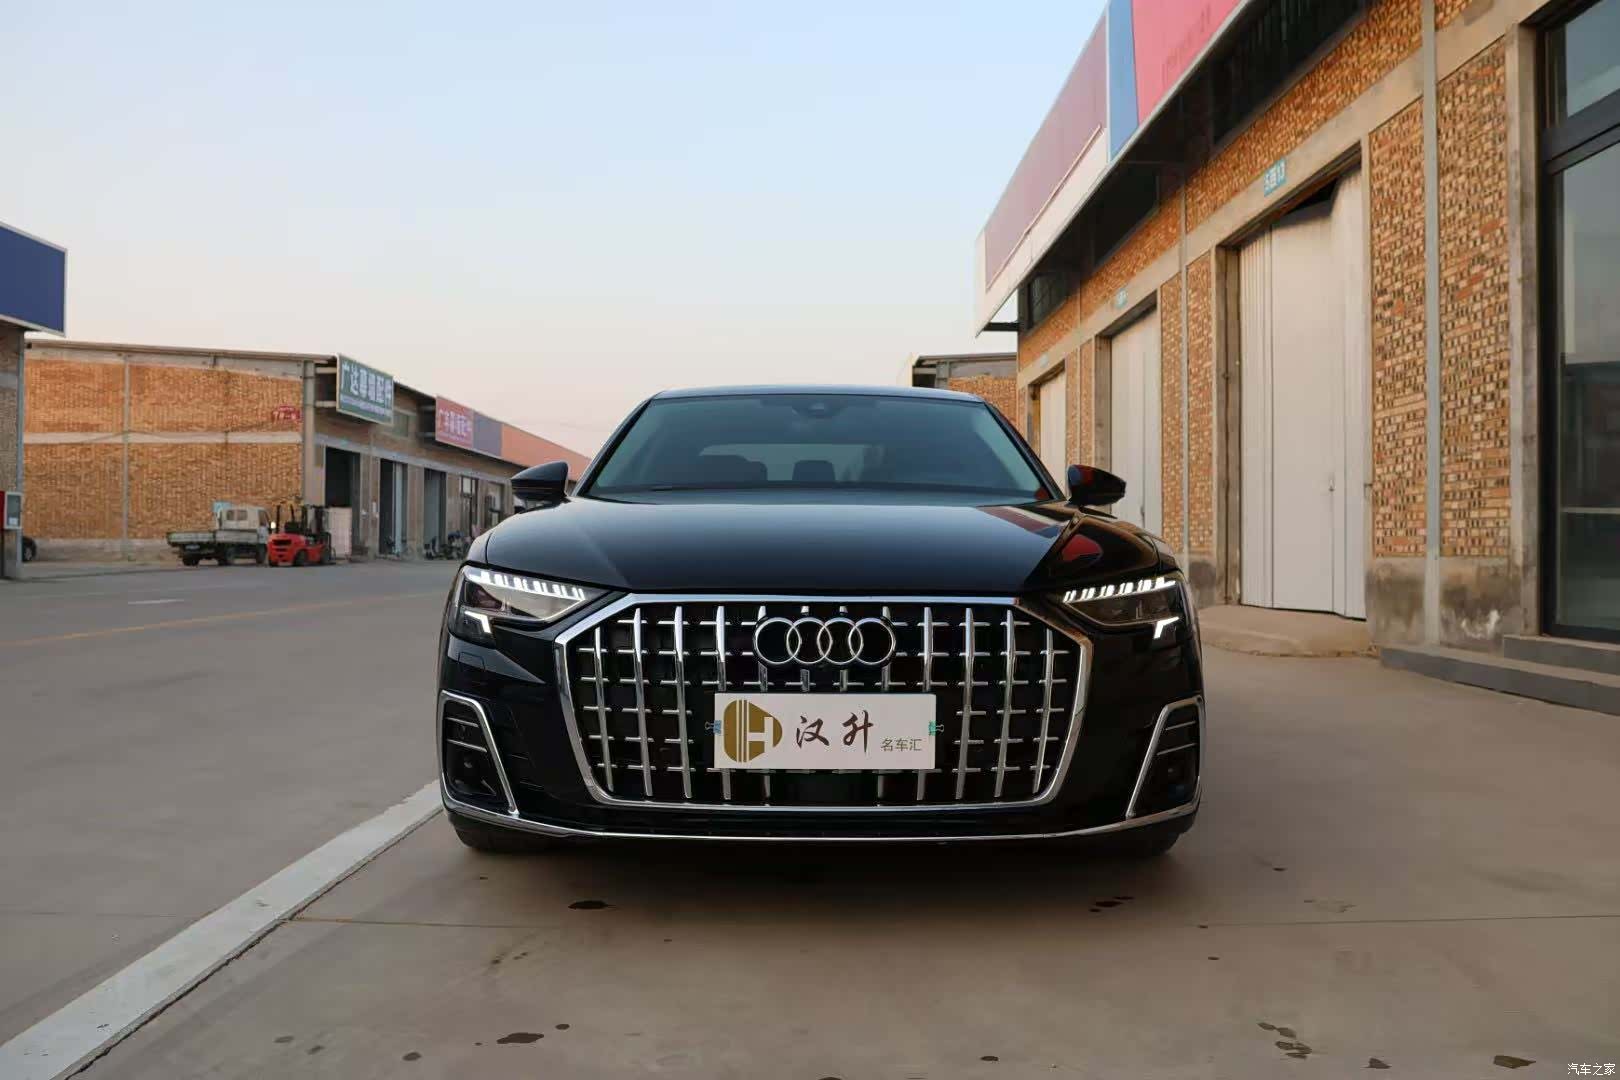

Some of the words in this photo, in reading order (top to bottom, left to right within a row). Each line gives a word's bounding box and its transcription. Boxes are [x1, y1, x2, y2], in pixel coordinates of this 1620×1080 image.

[796, 709, 874, 753] 汉升
[880, 738, 923, 752] 名车汇
